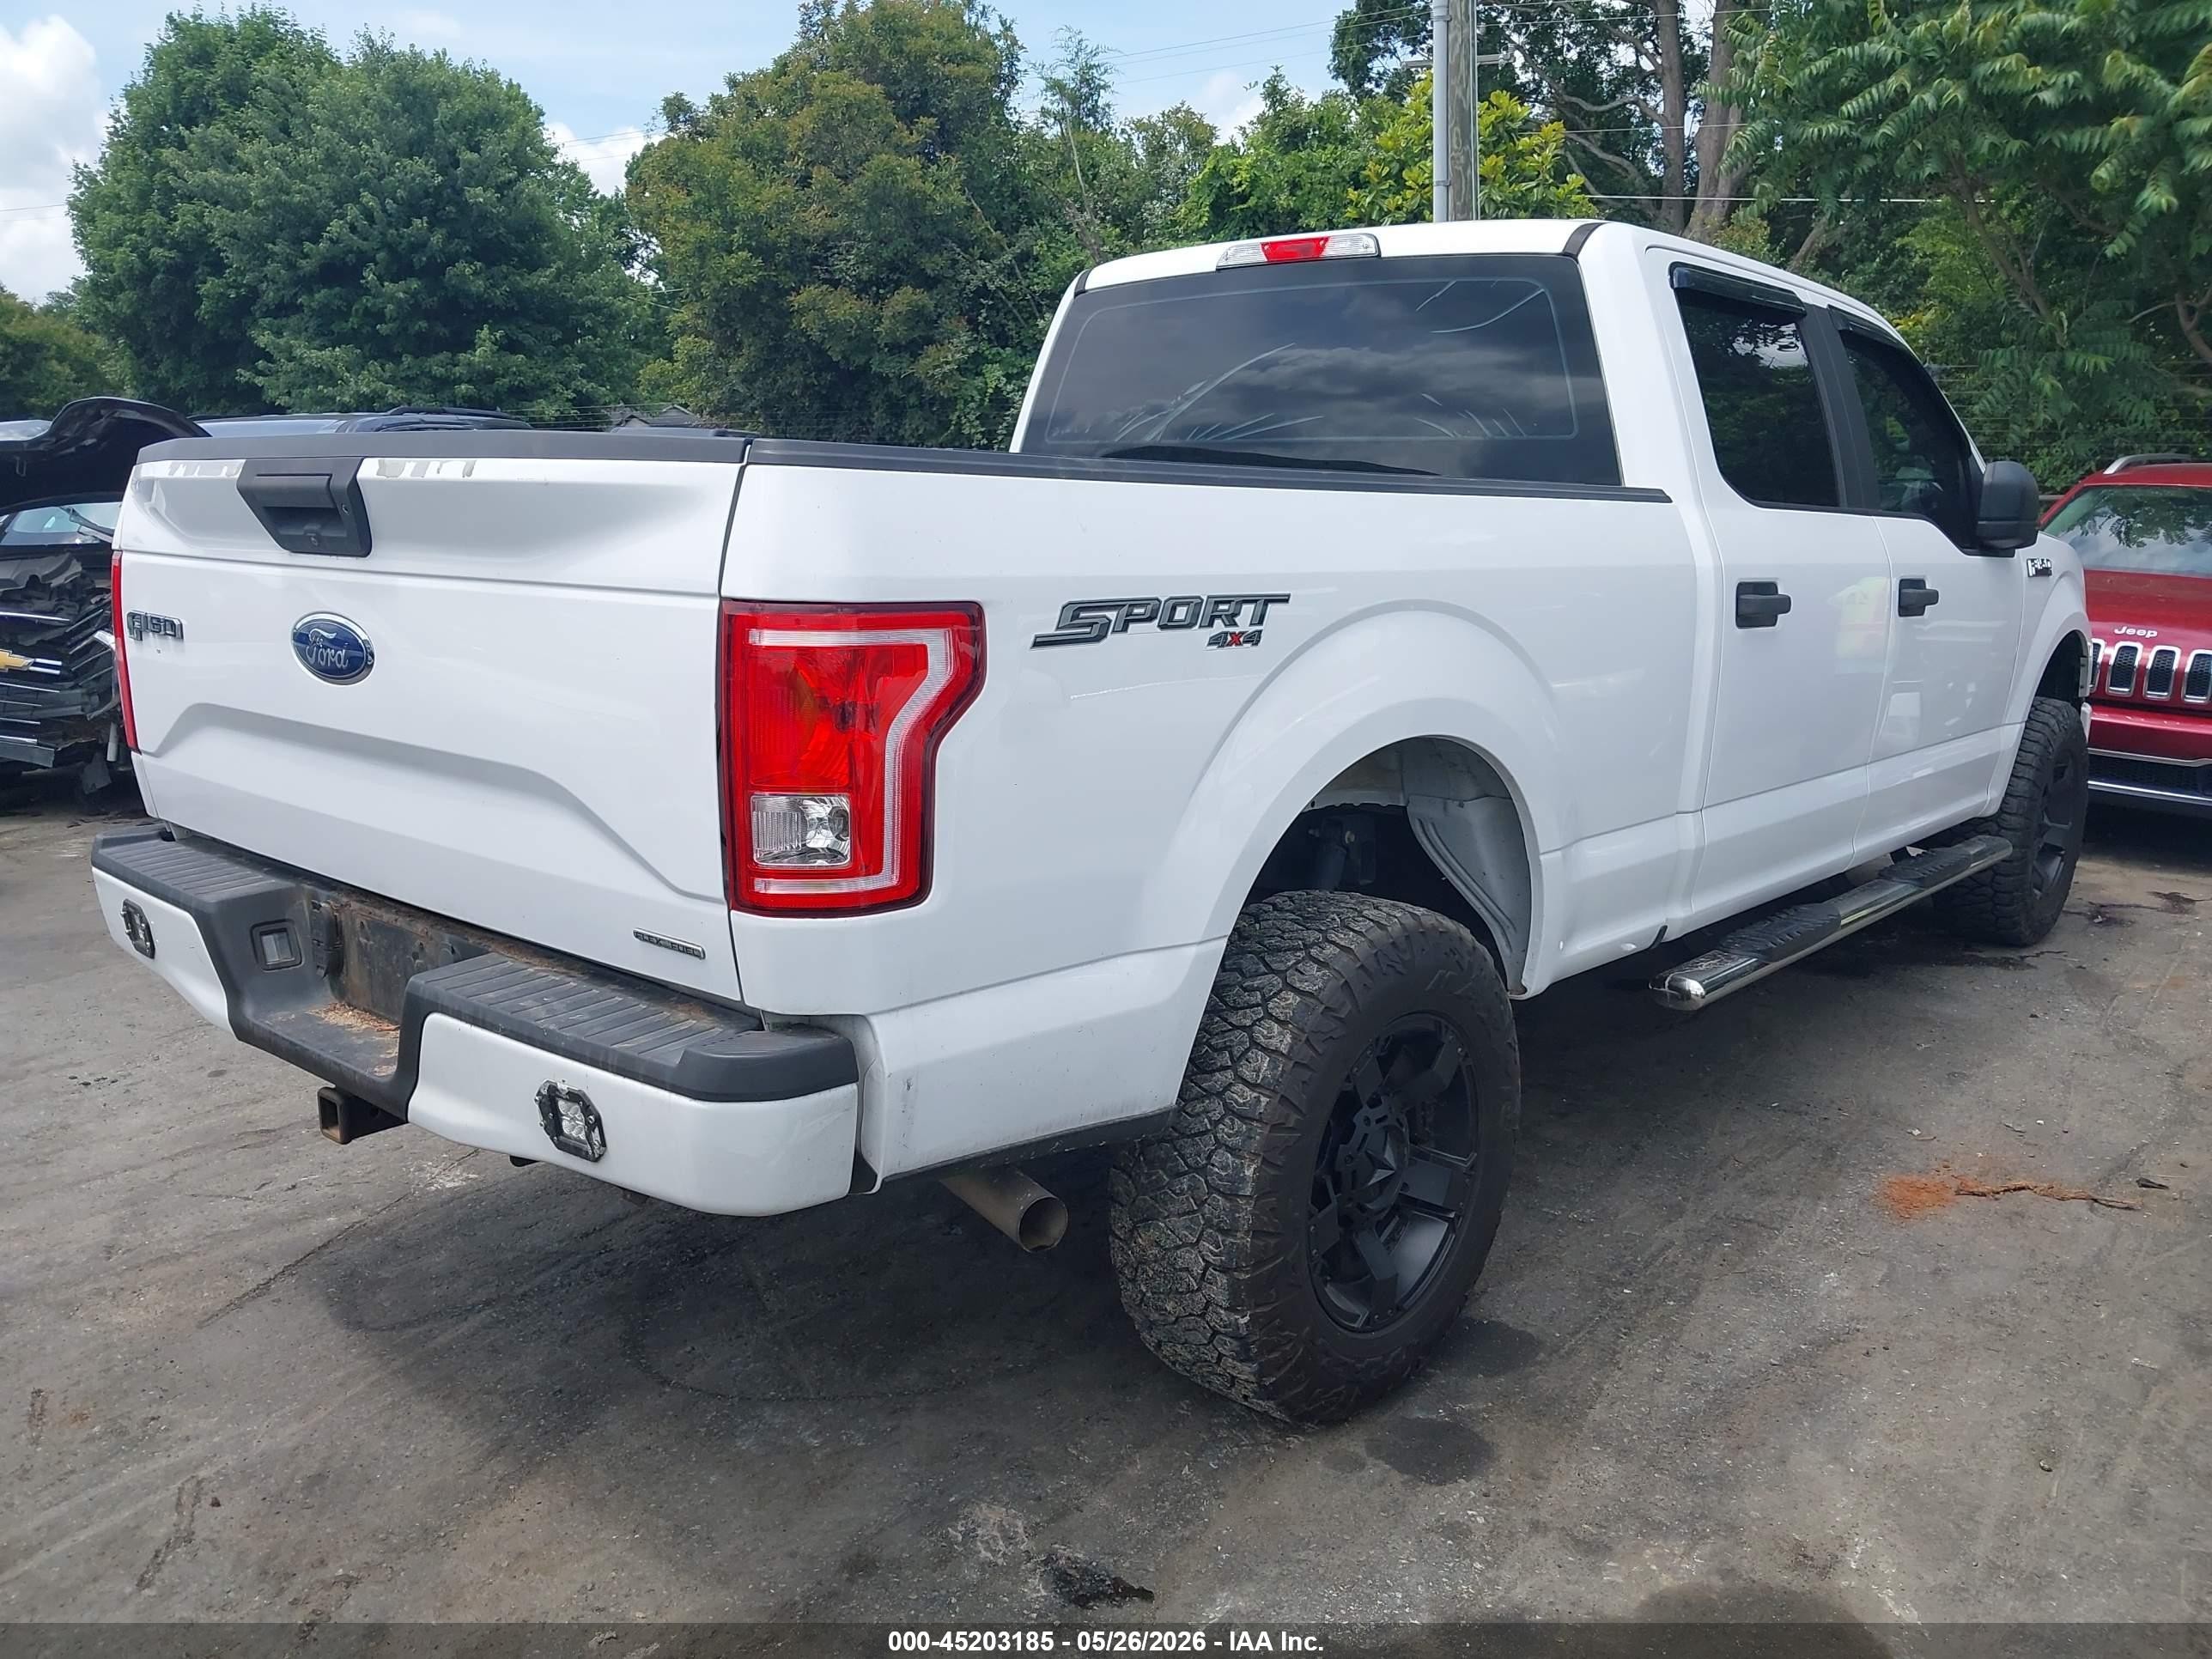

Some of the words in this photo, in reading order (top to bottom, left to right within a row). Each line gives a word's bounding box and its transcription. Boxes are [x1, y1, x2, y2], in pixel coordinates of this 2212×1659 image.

[1030, 593, 1291, 648] SPORT
[2113, 626, 2158, 639] Jeep
[306, 628, 349, 669] Ford
